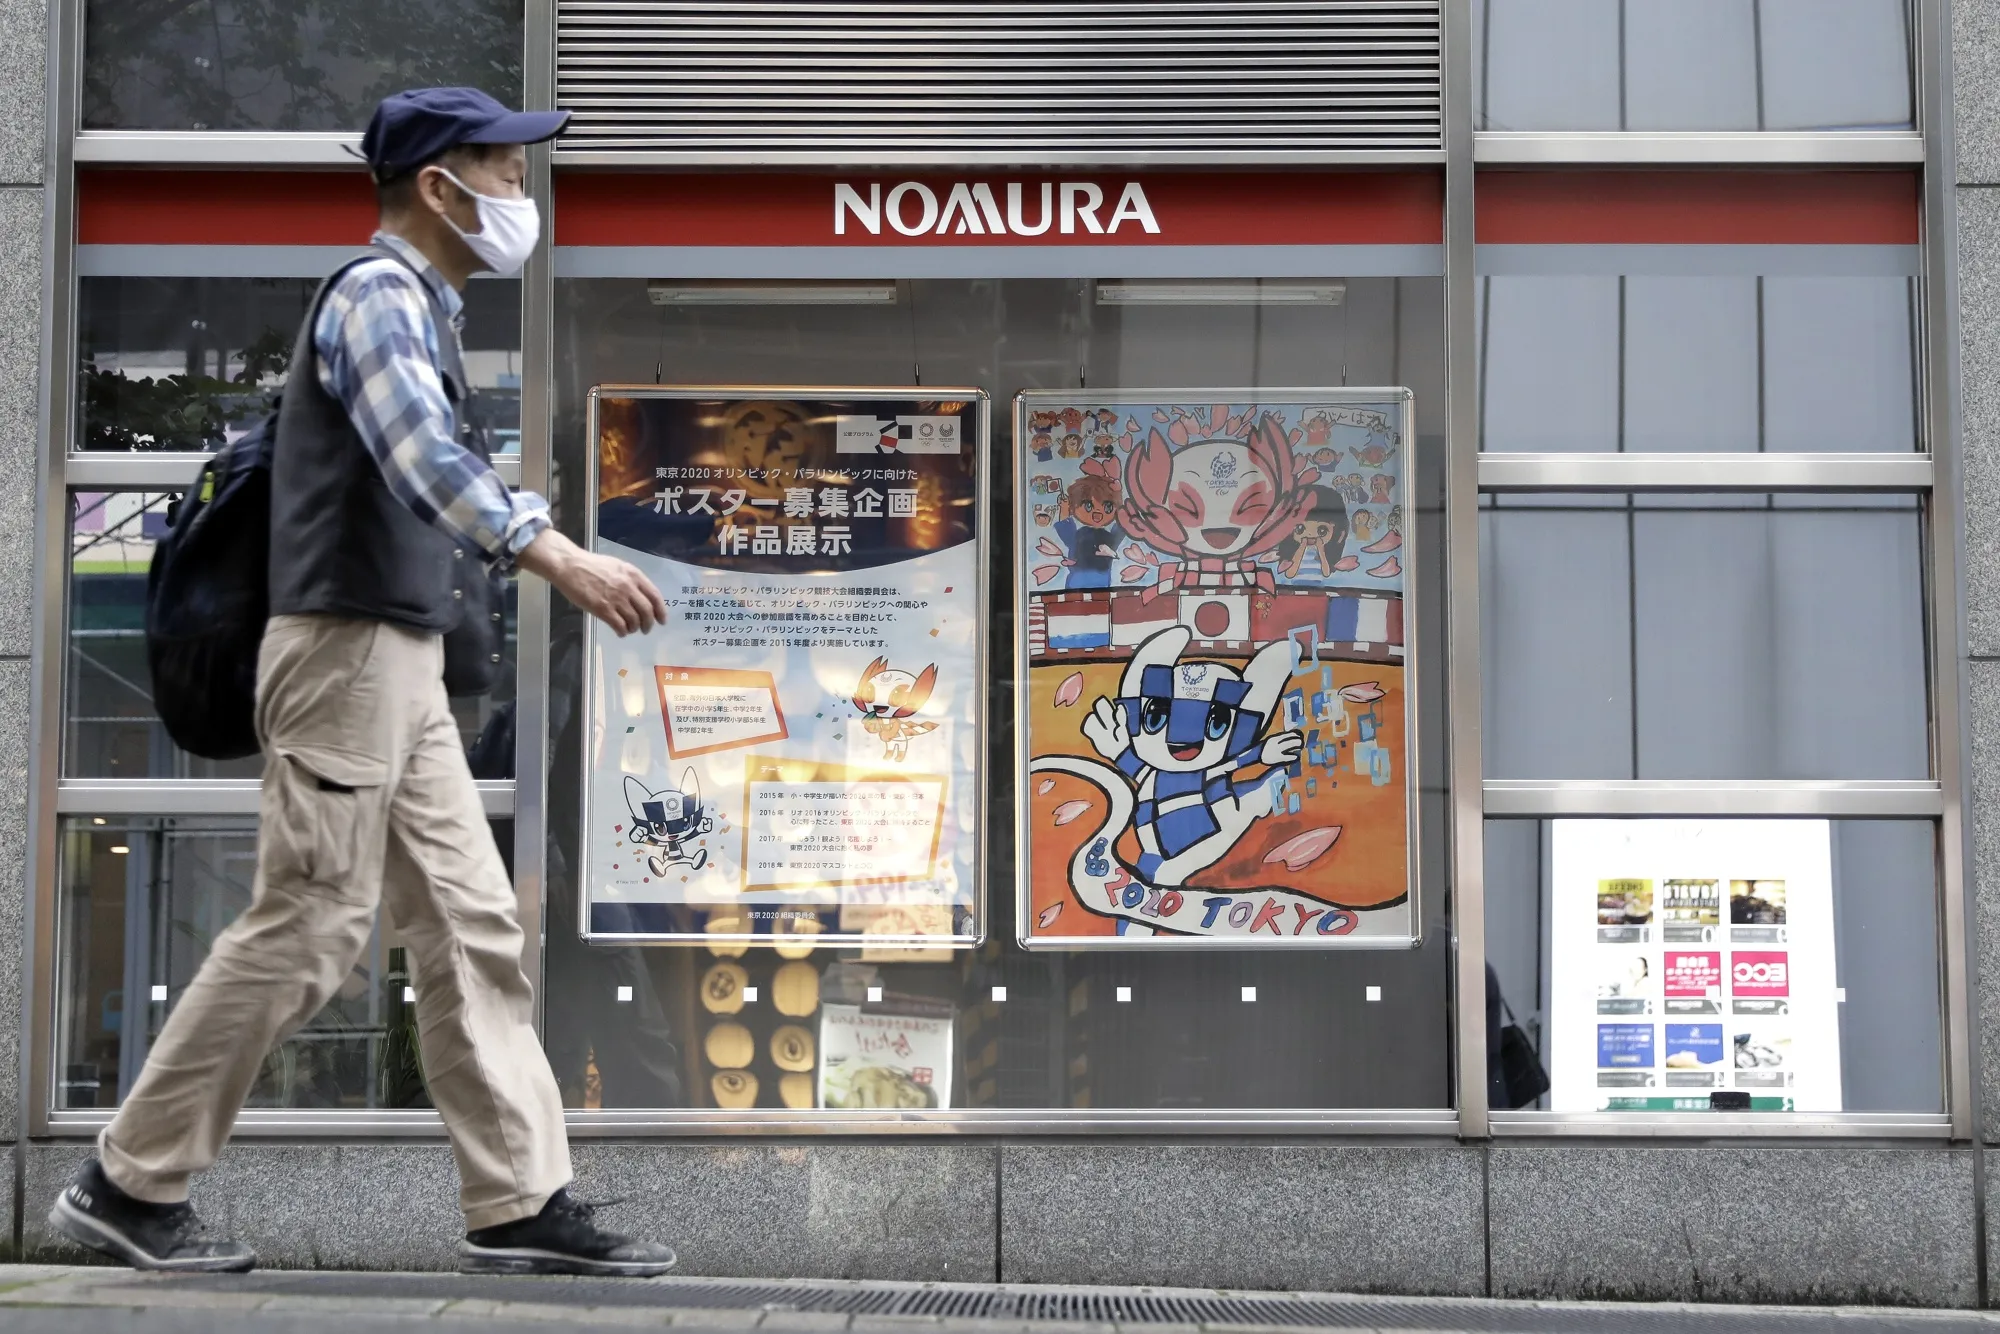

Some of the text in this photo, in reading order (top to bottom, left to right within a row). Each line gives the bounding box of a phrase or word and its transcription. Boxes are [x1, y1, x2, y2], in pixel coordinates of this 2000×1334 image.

[834, 181, 1161, 237] NOMURA
[653, 485, 918, 518] ポスター募集企画
[717, 524, 852, 556] 作品展示
[663, 599, 929, 609] スターを描くことを通じて、オリンピック・パラリンピックへの関心や
[1104, 867, 1359, 936] 2020 TOKYO
